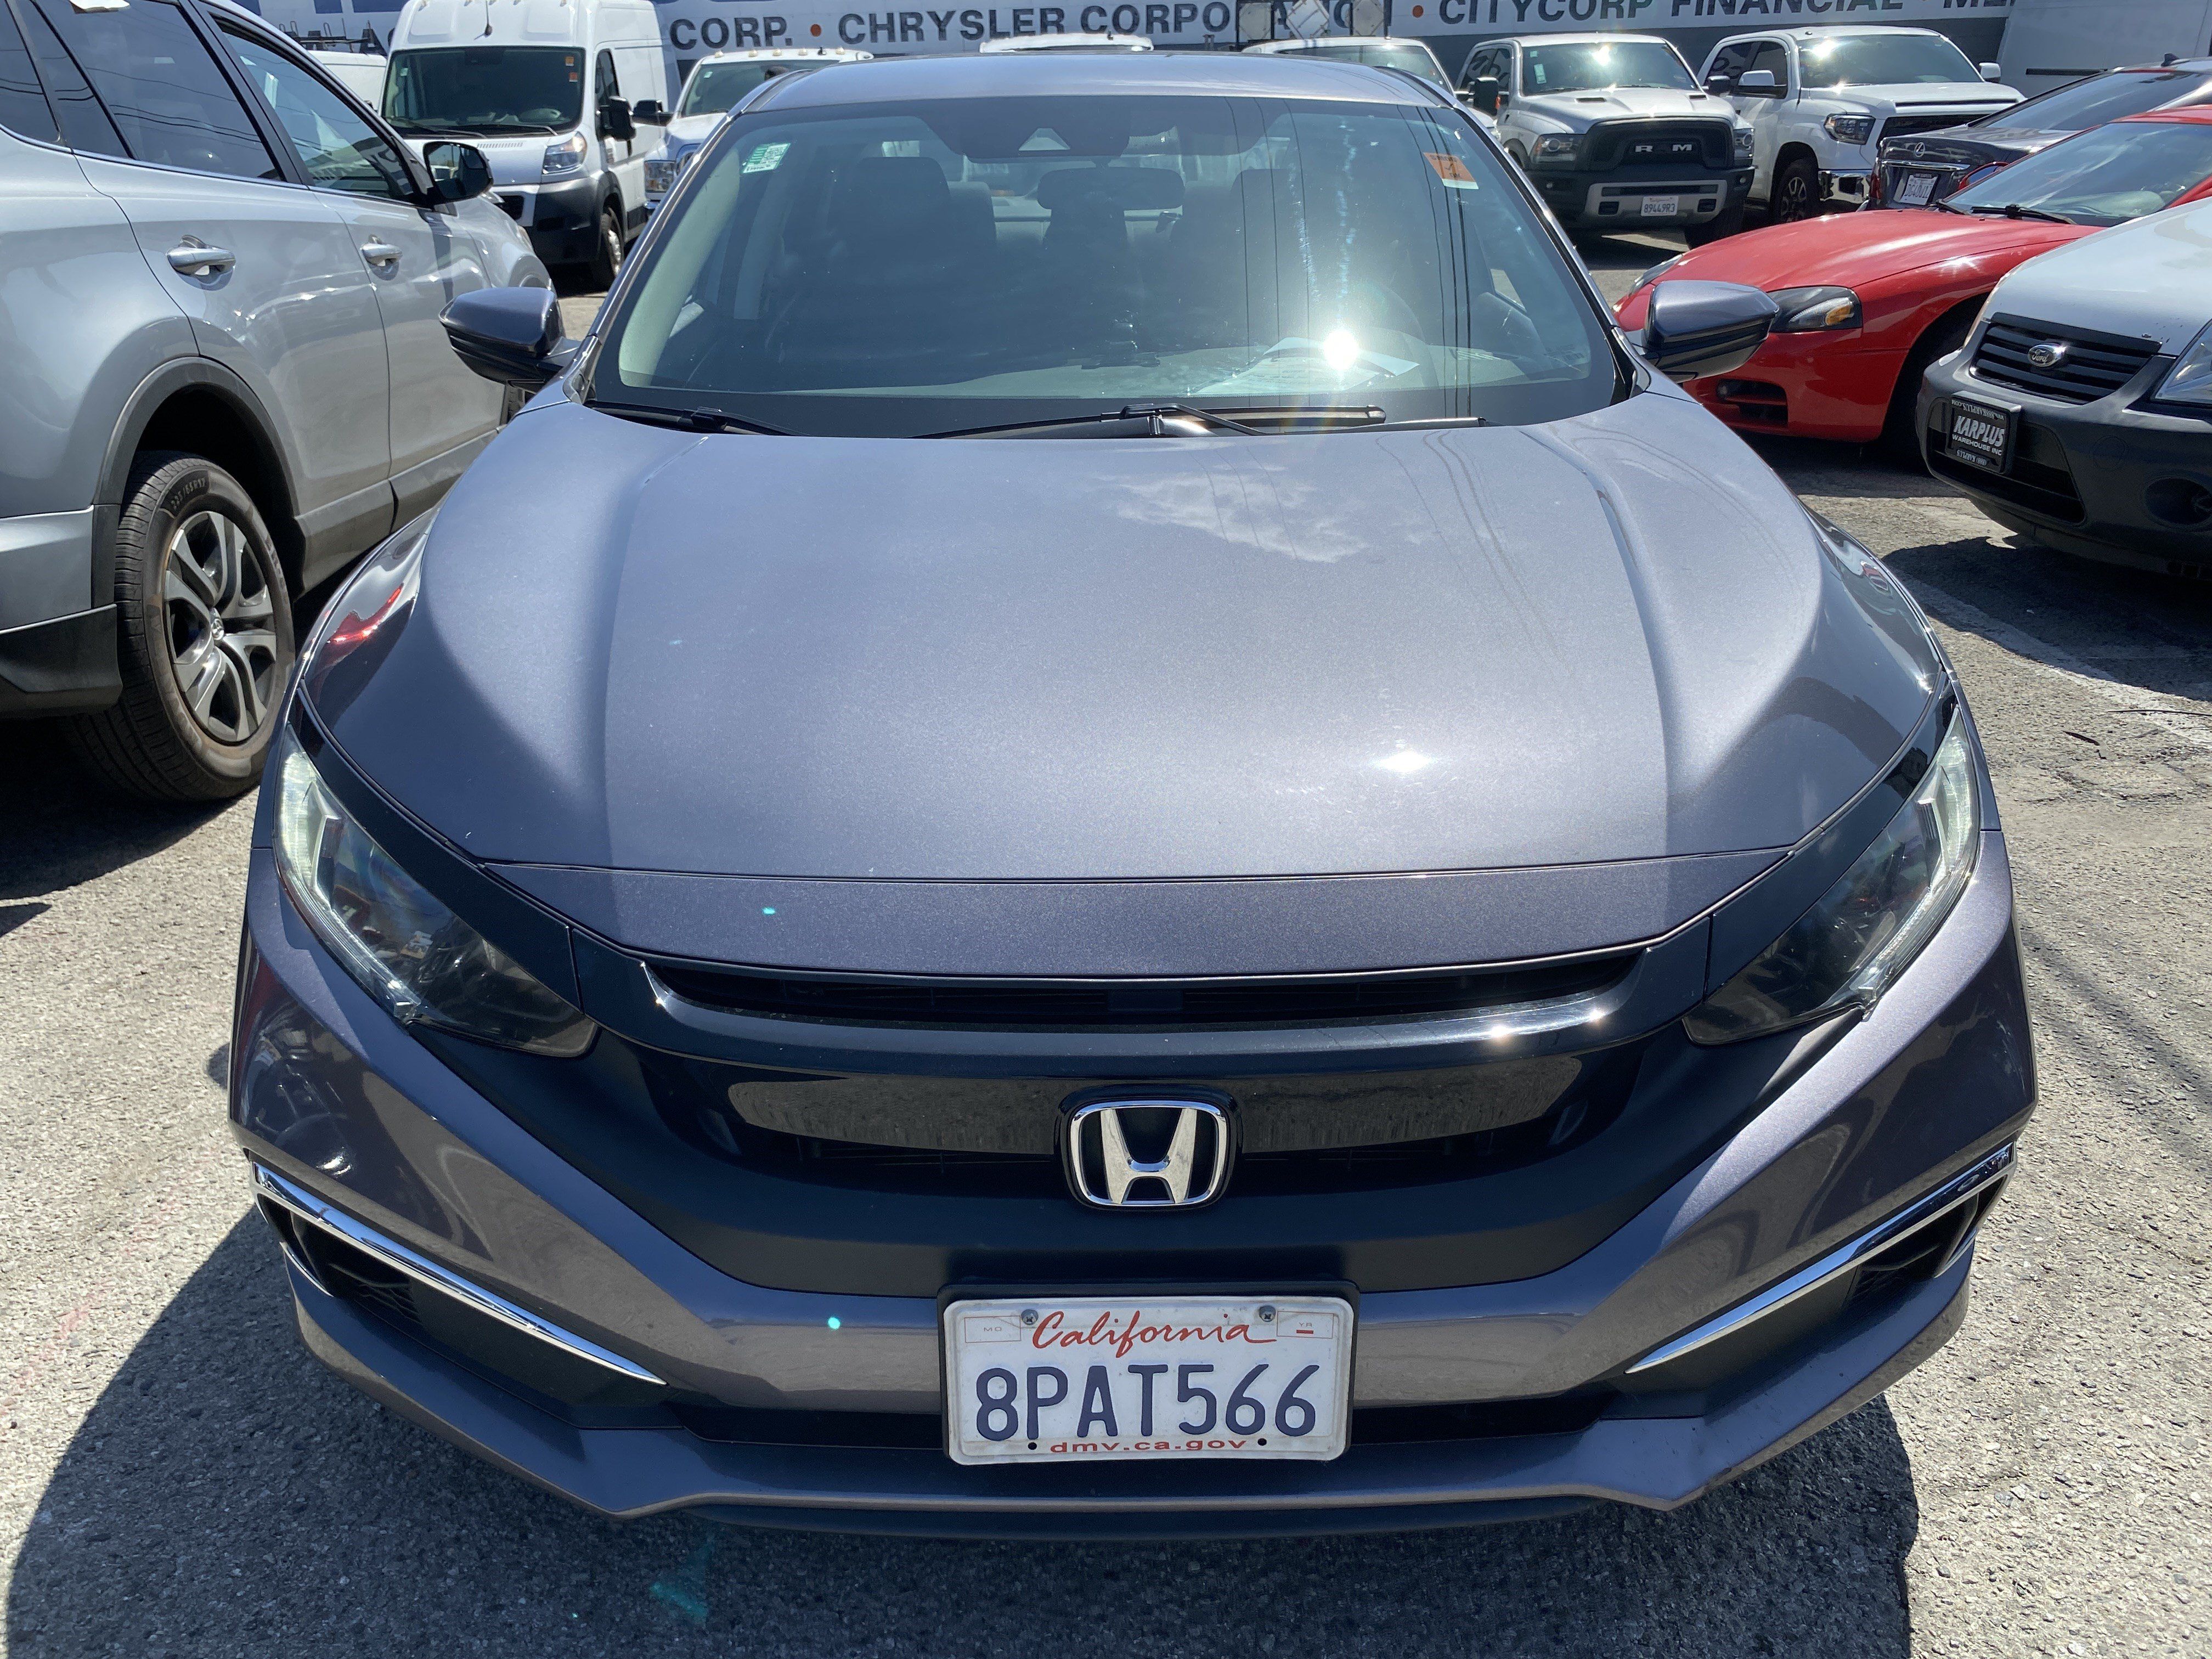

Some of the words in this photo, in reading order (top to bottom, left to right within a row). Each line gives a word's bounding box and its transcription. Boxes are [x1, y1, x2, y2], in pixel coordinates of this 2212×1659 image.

[670, 16, 792, 50] CORP.
[838, 8, 1066, 44] CHRYSLER
[1439, 0, 1647, 24] CITYCORP
[1635, 144, 1692, 153] RM
[1952, 434, 1991, 452] WAREHOUSE
[1992, 447, 2002, 456] INC
[1953, 415, 2005, 447] KARPLUS
[1032, 1310, 1277, 1358] California
[975, 1364, 1320, 1441] 8PAT566
[1050, 1439, 1247, 1453] dmv.ca.gov
